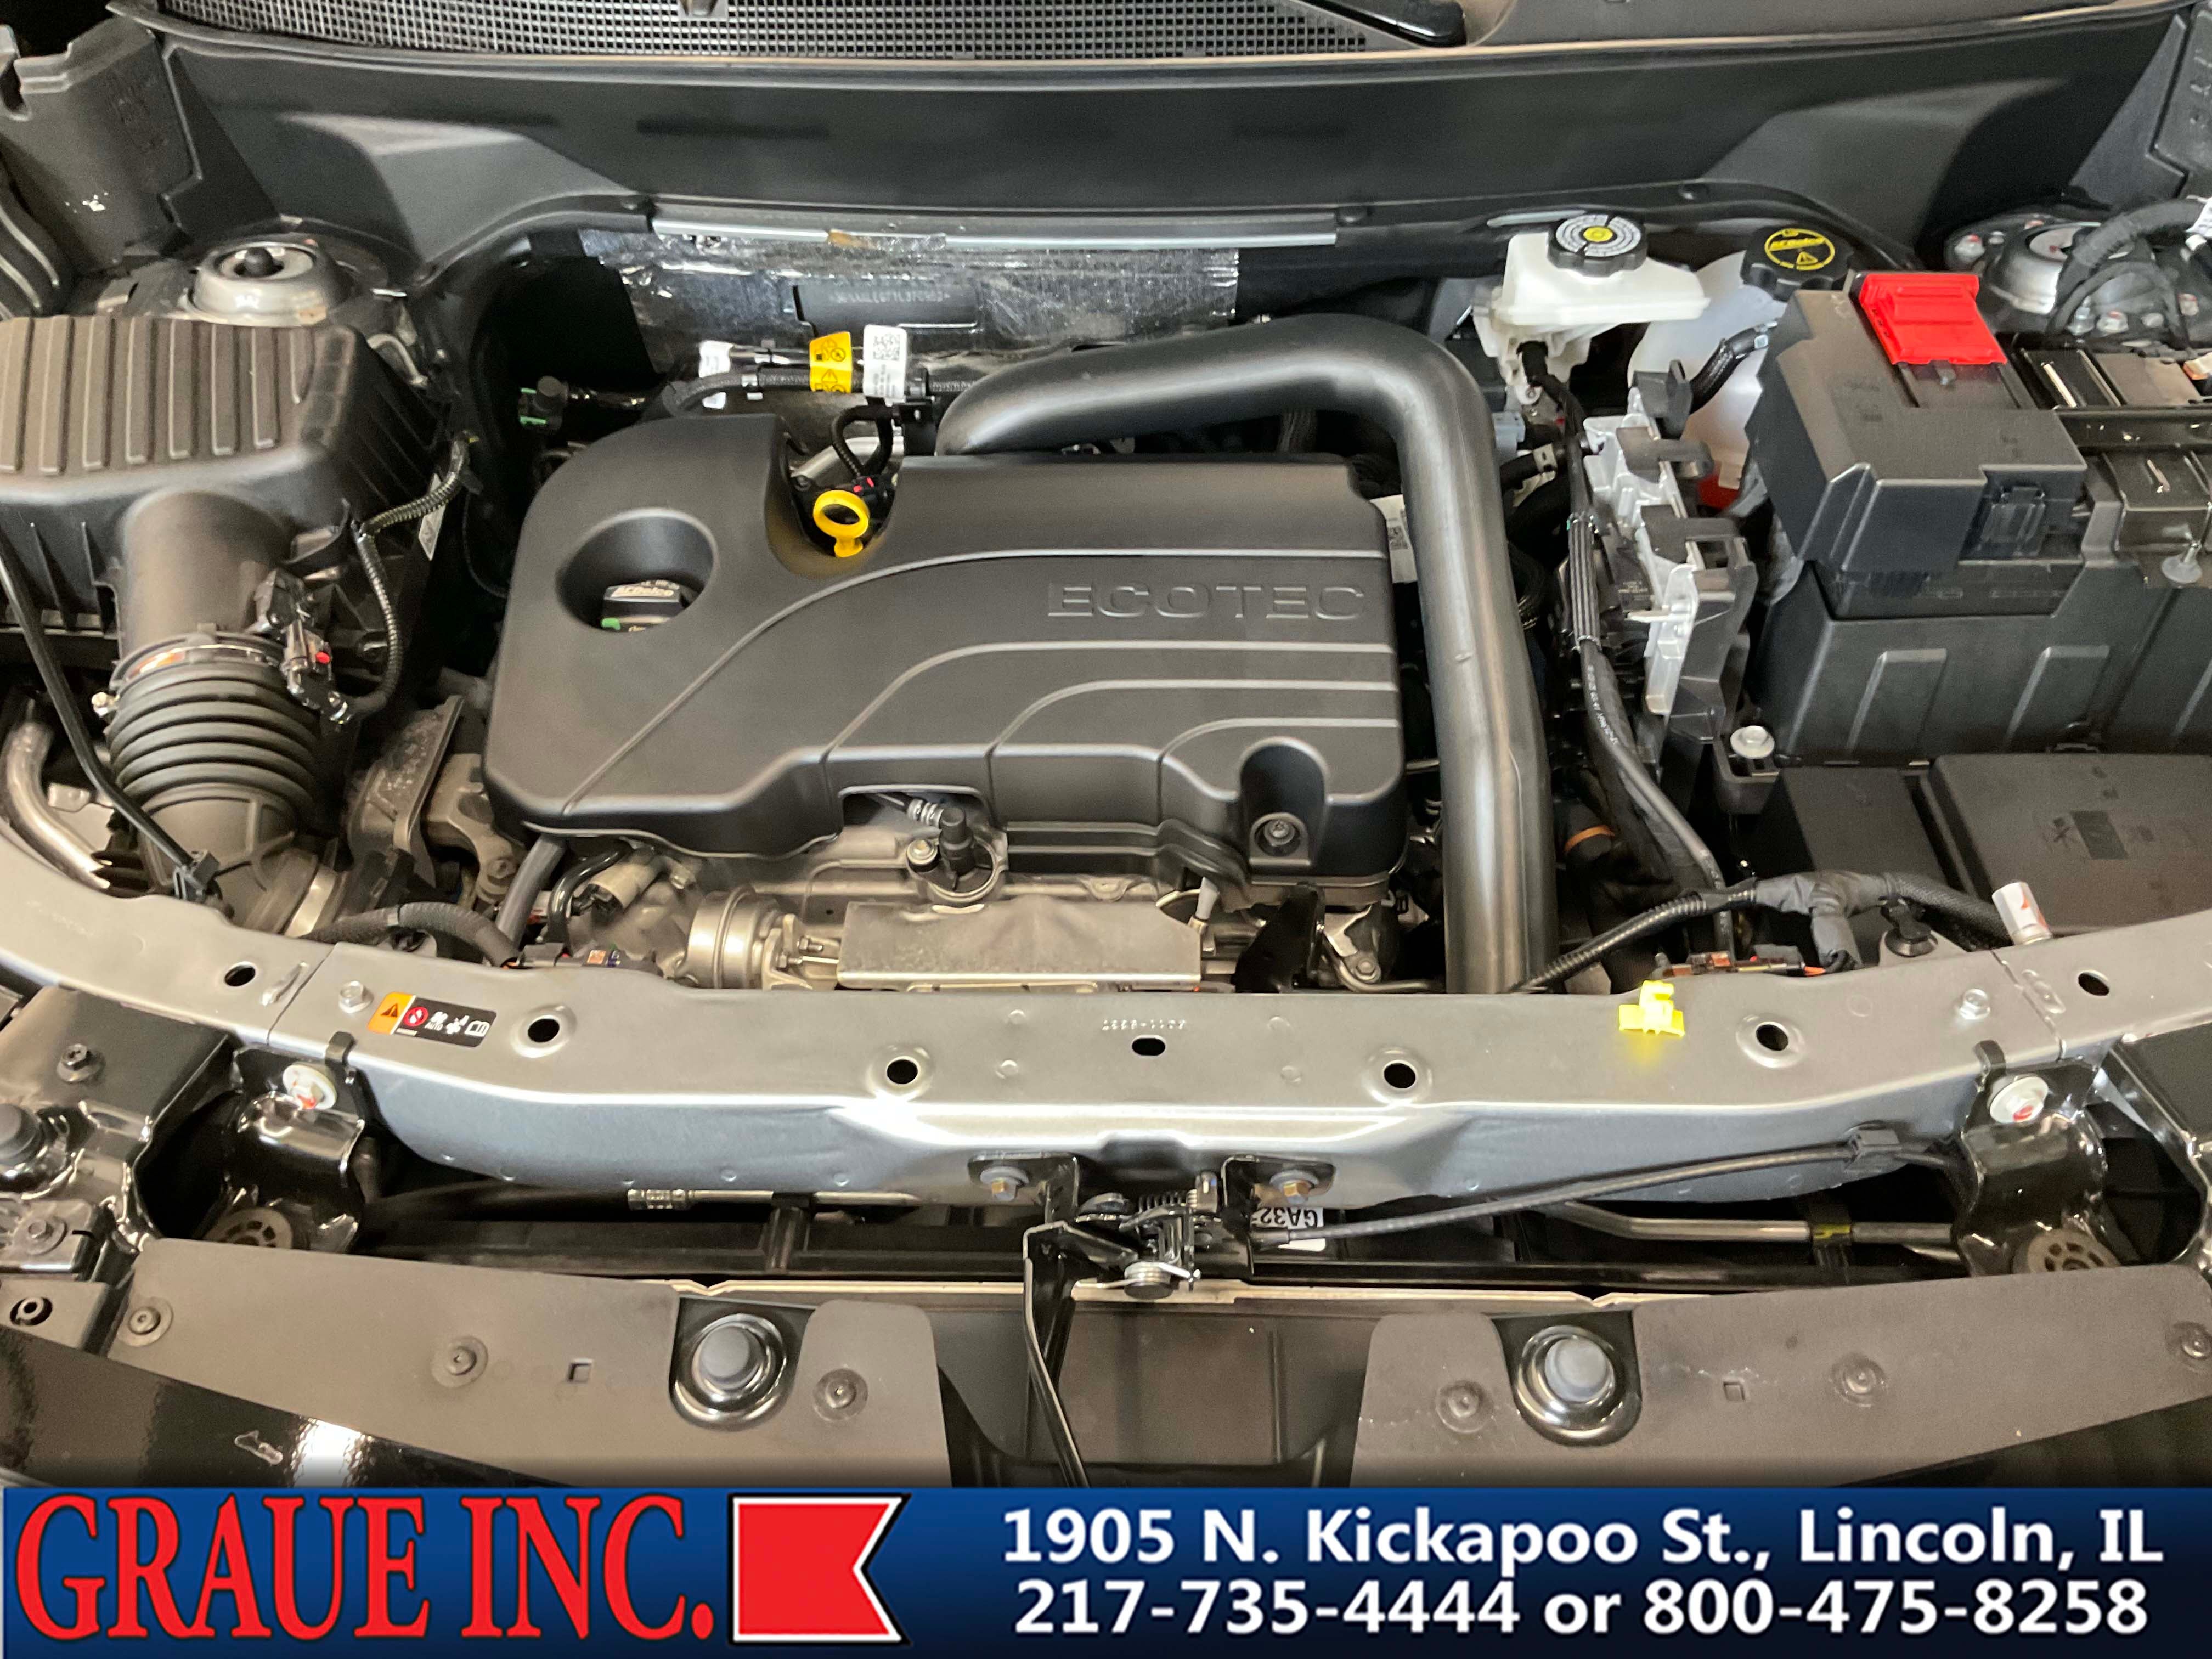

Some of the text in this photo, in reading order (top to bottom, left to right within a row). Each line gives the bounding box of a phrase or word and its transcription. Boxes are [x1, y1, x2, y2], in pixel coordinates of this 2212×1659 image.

[1047, 584, 1364, 619] ECOTEC
[425, 1022, 443, 1031] AUTO
[1252, 1206, 1318, 1229] GA32
